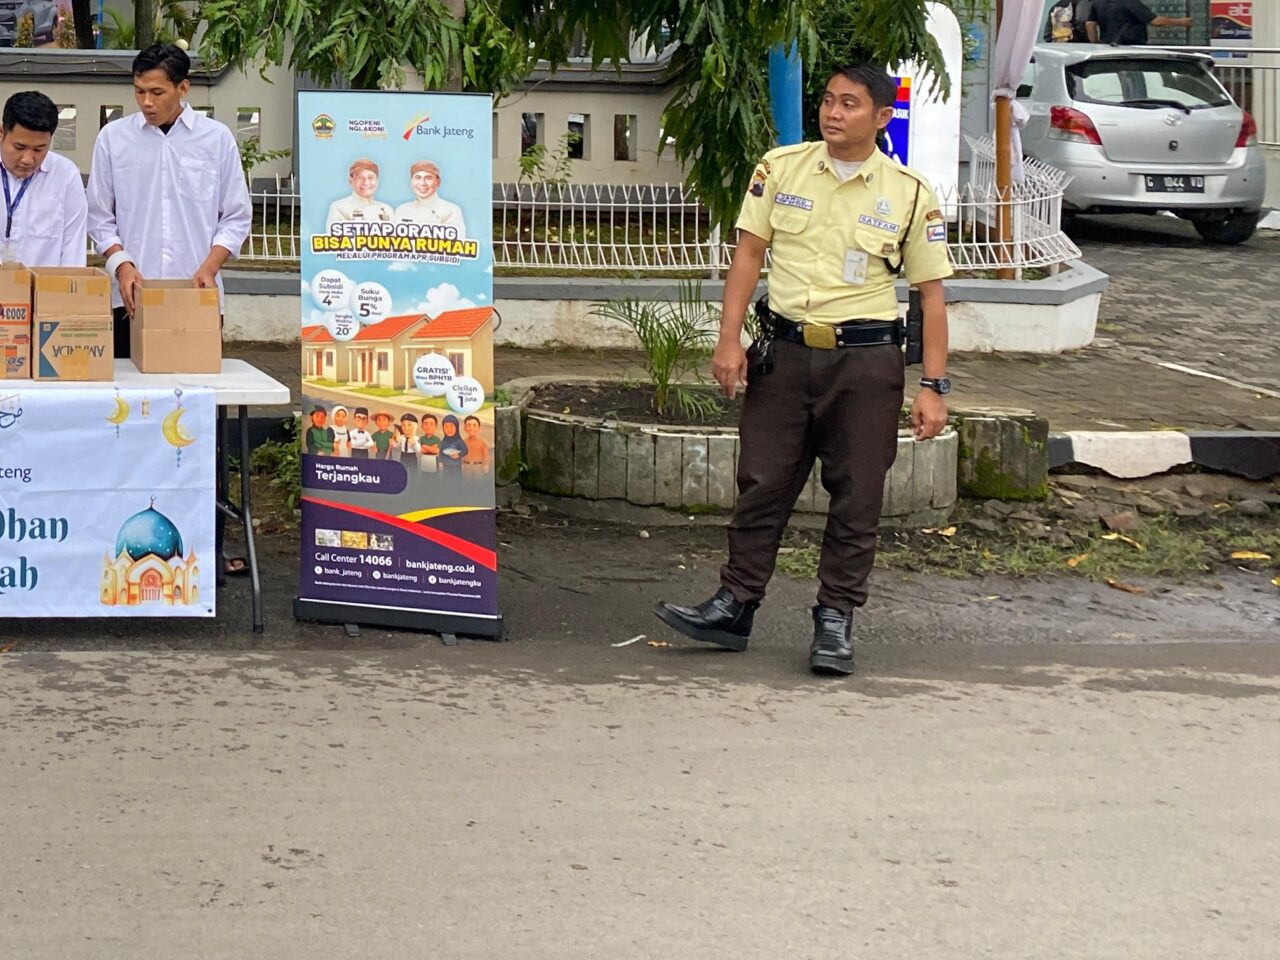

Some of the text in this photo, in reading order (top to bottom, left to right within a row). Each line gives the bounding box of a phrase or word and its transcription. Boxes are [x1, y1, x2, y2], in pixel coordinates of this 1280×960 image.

[416, 125, 474, 139] Bank Jateng
[1146, 176, 1154, 187] G
[1163, 176, 1185, 187] 1044
[861, 216, 897, 231] SATPAM
[331, 223, 458, 240] SETIAP ORANG
[313, 236, 477, 257] BISA PUNYA RUMAH
[371, 252, 410, 260] PROGRAM
[411, 253, 428, 261] KPR
[428, 254, 460, 264] SUBSIDI
[320, 276, 341, 284] Dapat
[322, 295, 332, 306] 4
[358, 294, 383, 303] Bunga
[452, 384, 478, 392] Cicilan
[457, 395, 464, 408] 1
[315, 463, 359, 472] Harga Rumah
[315, 470, 380, 484] Terjangkau
[314, 552, 475, 574] Call Center 14066 bankjateng.co.id
[324, 567, 482, 587] bank_jateng bankjateng bankjatengku
